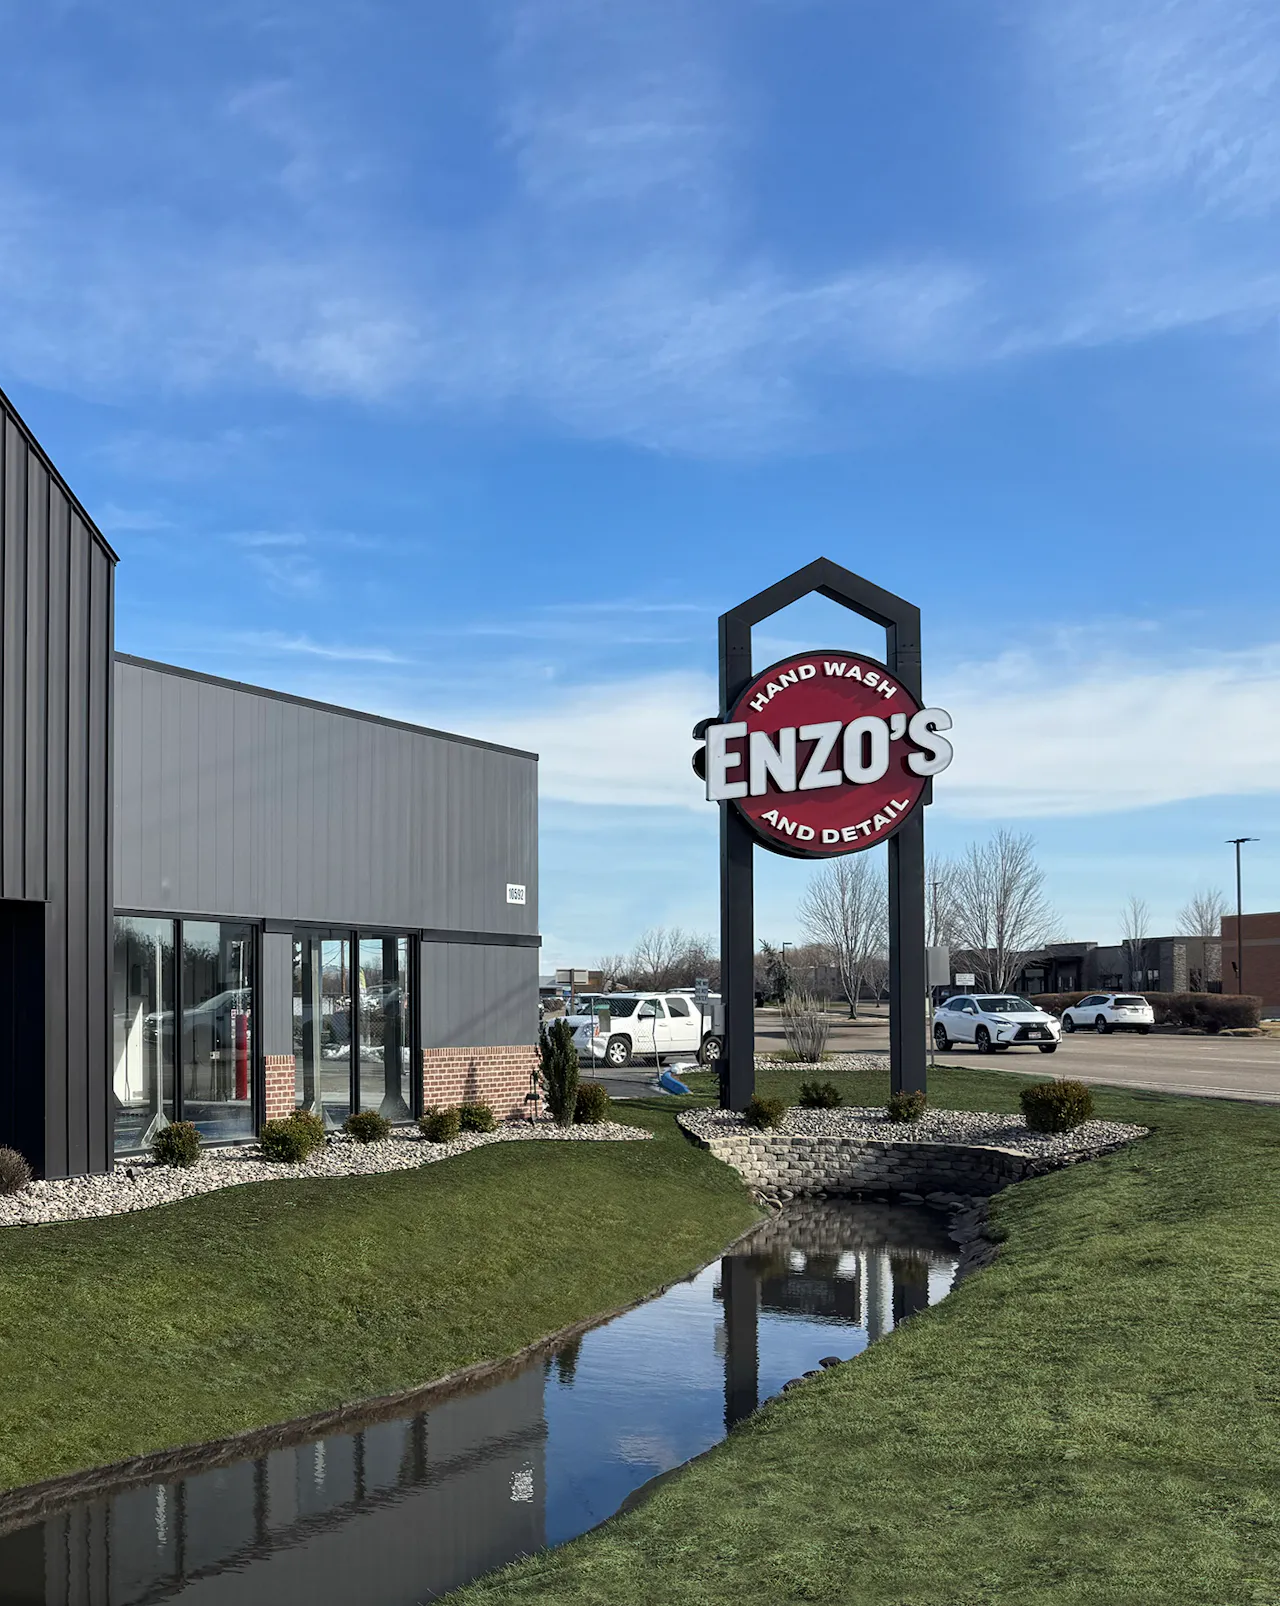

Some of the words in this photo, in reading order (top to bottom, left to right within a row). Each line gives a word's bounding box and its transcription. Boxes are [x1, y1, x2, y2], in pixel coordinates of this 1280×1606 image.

[749, 664, 817, 712] HAND
[823, 661, 897, 699] WASH
[705, 707, 954, 801] ENZO'S
[761, 809, 815, 841] AND
[822, 797, 910, 844] DETAIL
[508, 888, 524, 900] 10592
